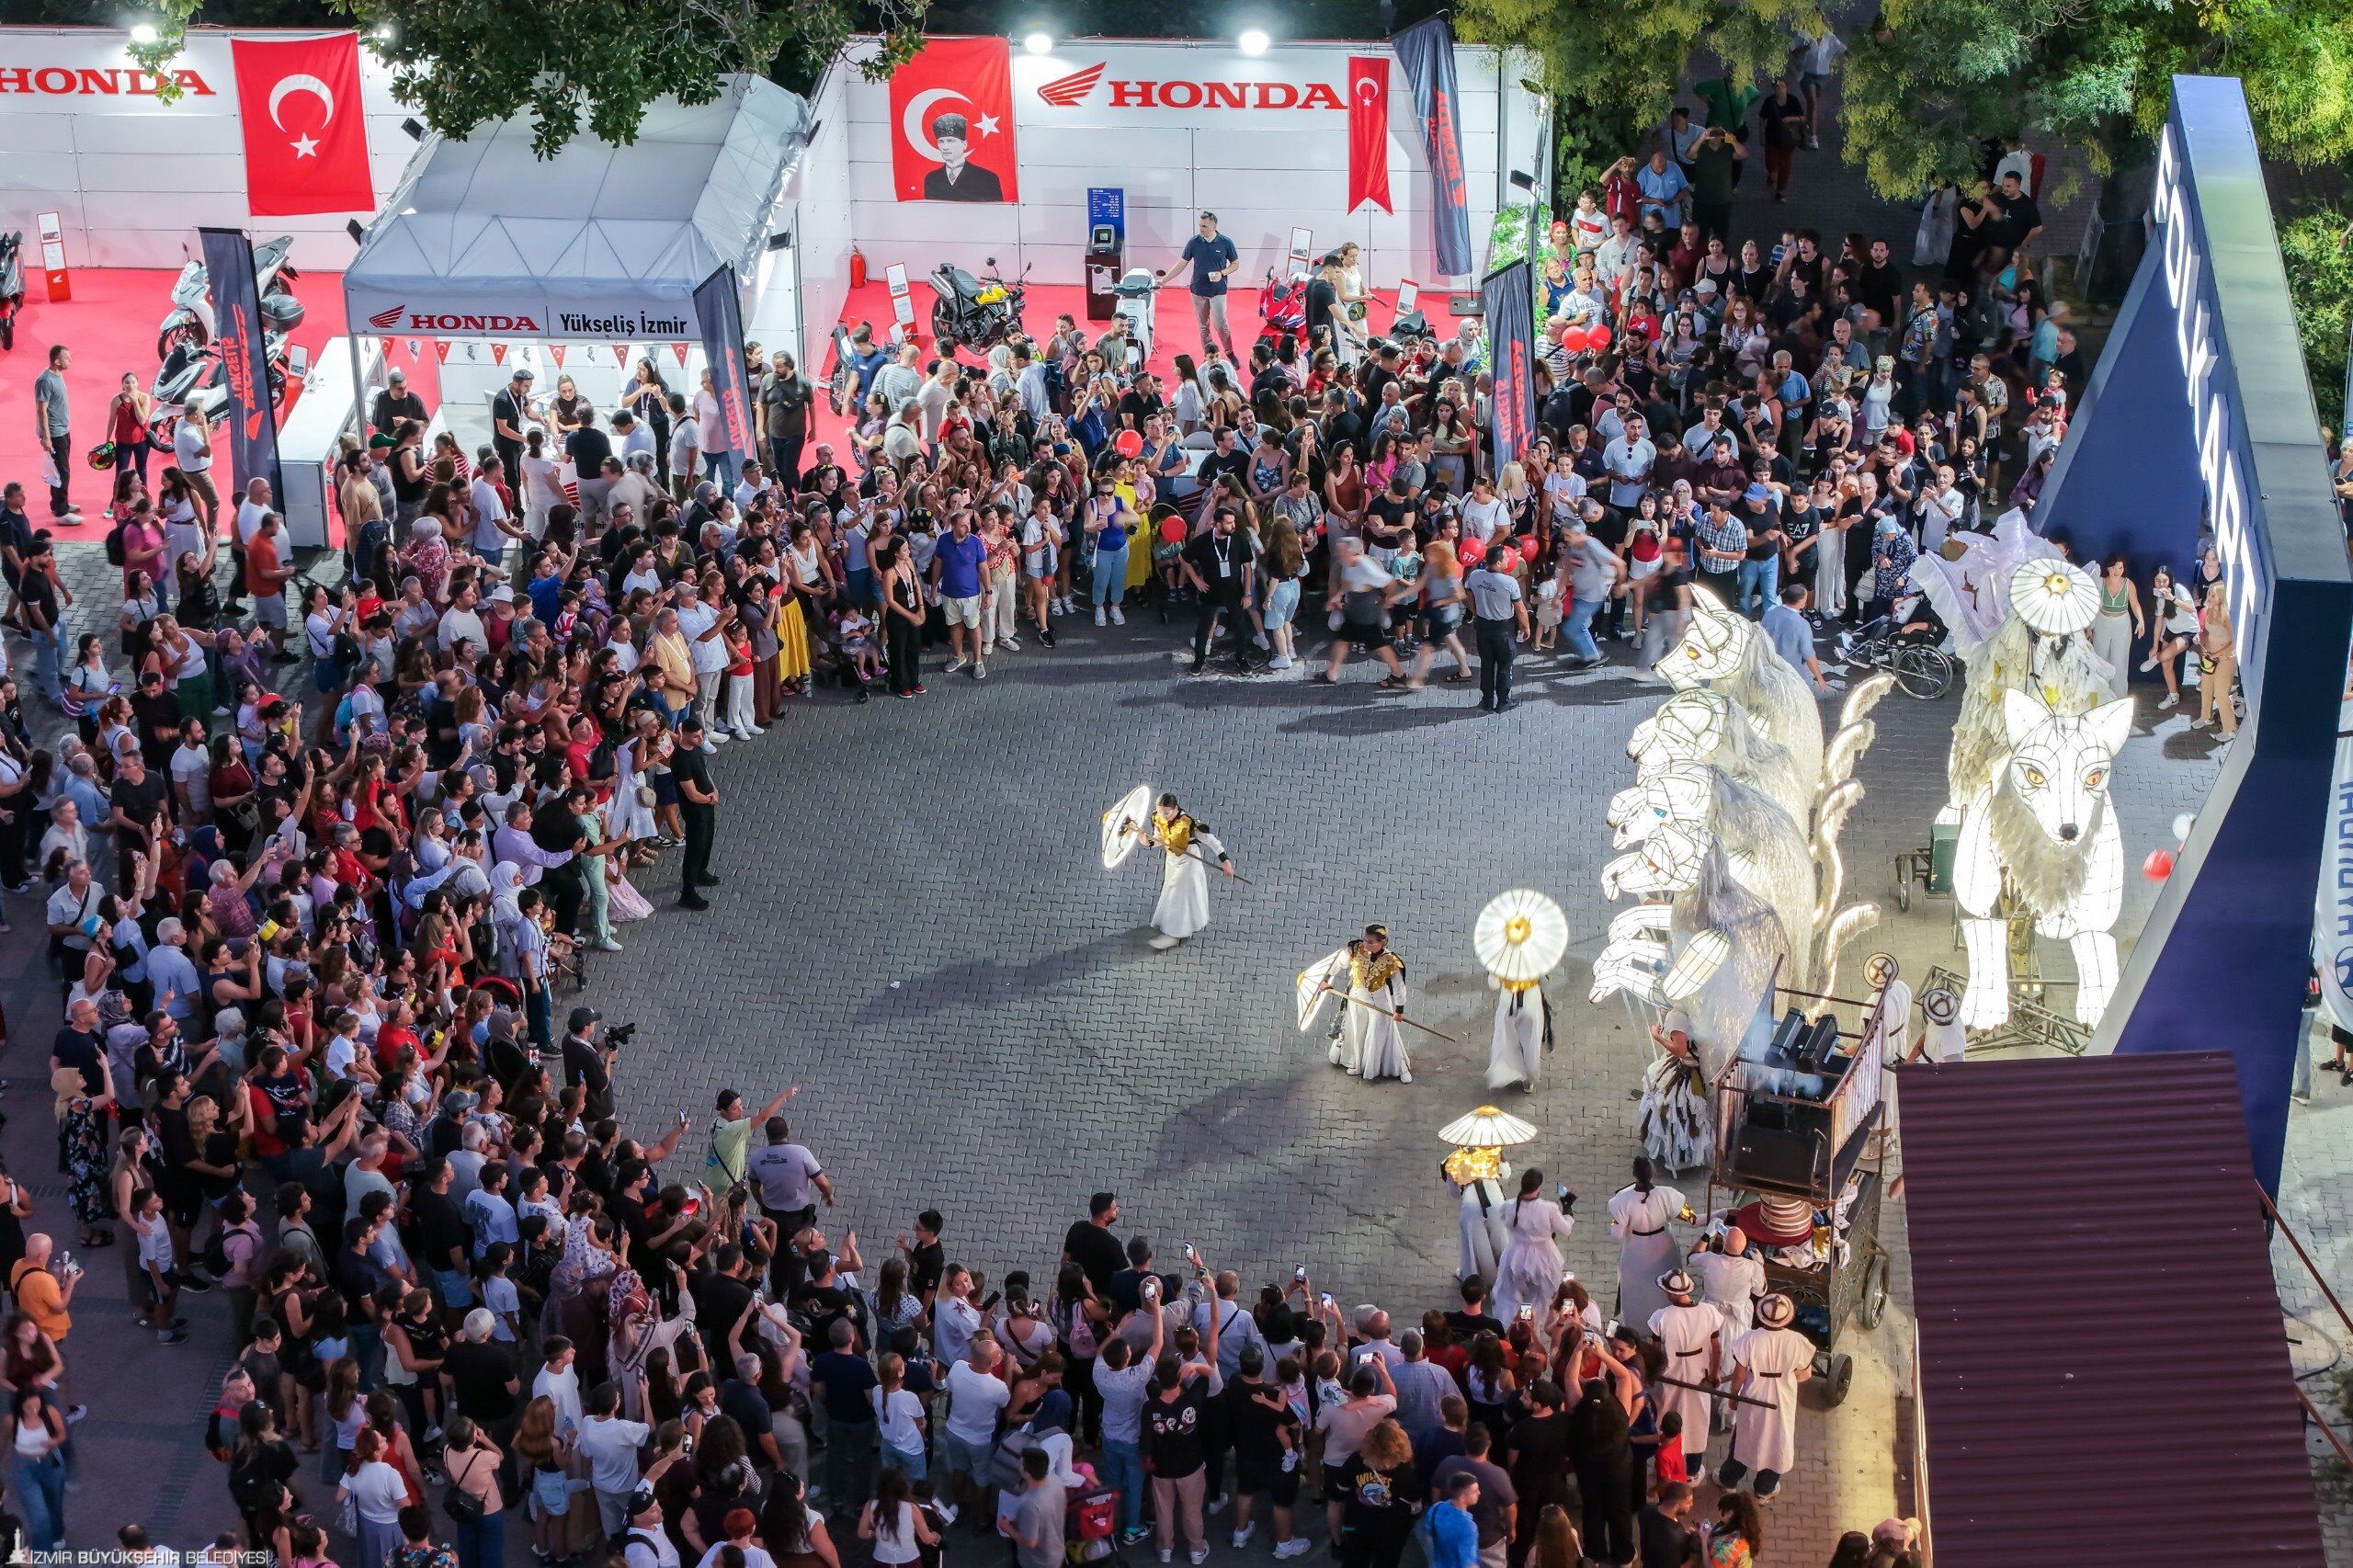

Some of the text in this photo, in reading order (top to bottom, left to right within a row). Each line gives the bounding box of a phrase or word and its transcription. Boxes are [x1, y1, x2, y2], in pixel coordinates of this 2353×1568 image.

[0, 67, 217, 96] HONDA
[1108, 80, 1348, 109] HONDA
[410, 314, 540, 331] HONDA
[559, 311, 687, 336] Yükseliş İzmir
[2154, 123, 2265, 667] FOLKART
[1787, 523, 1810, 535] EA7
